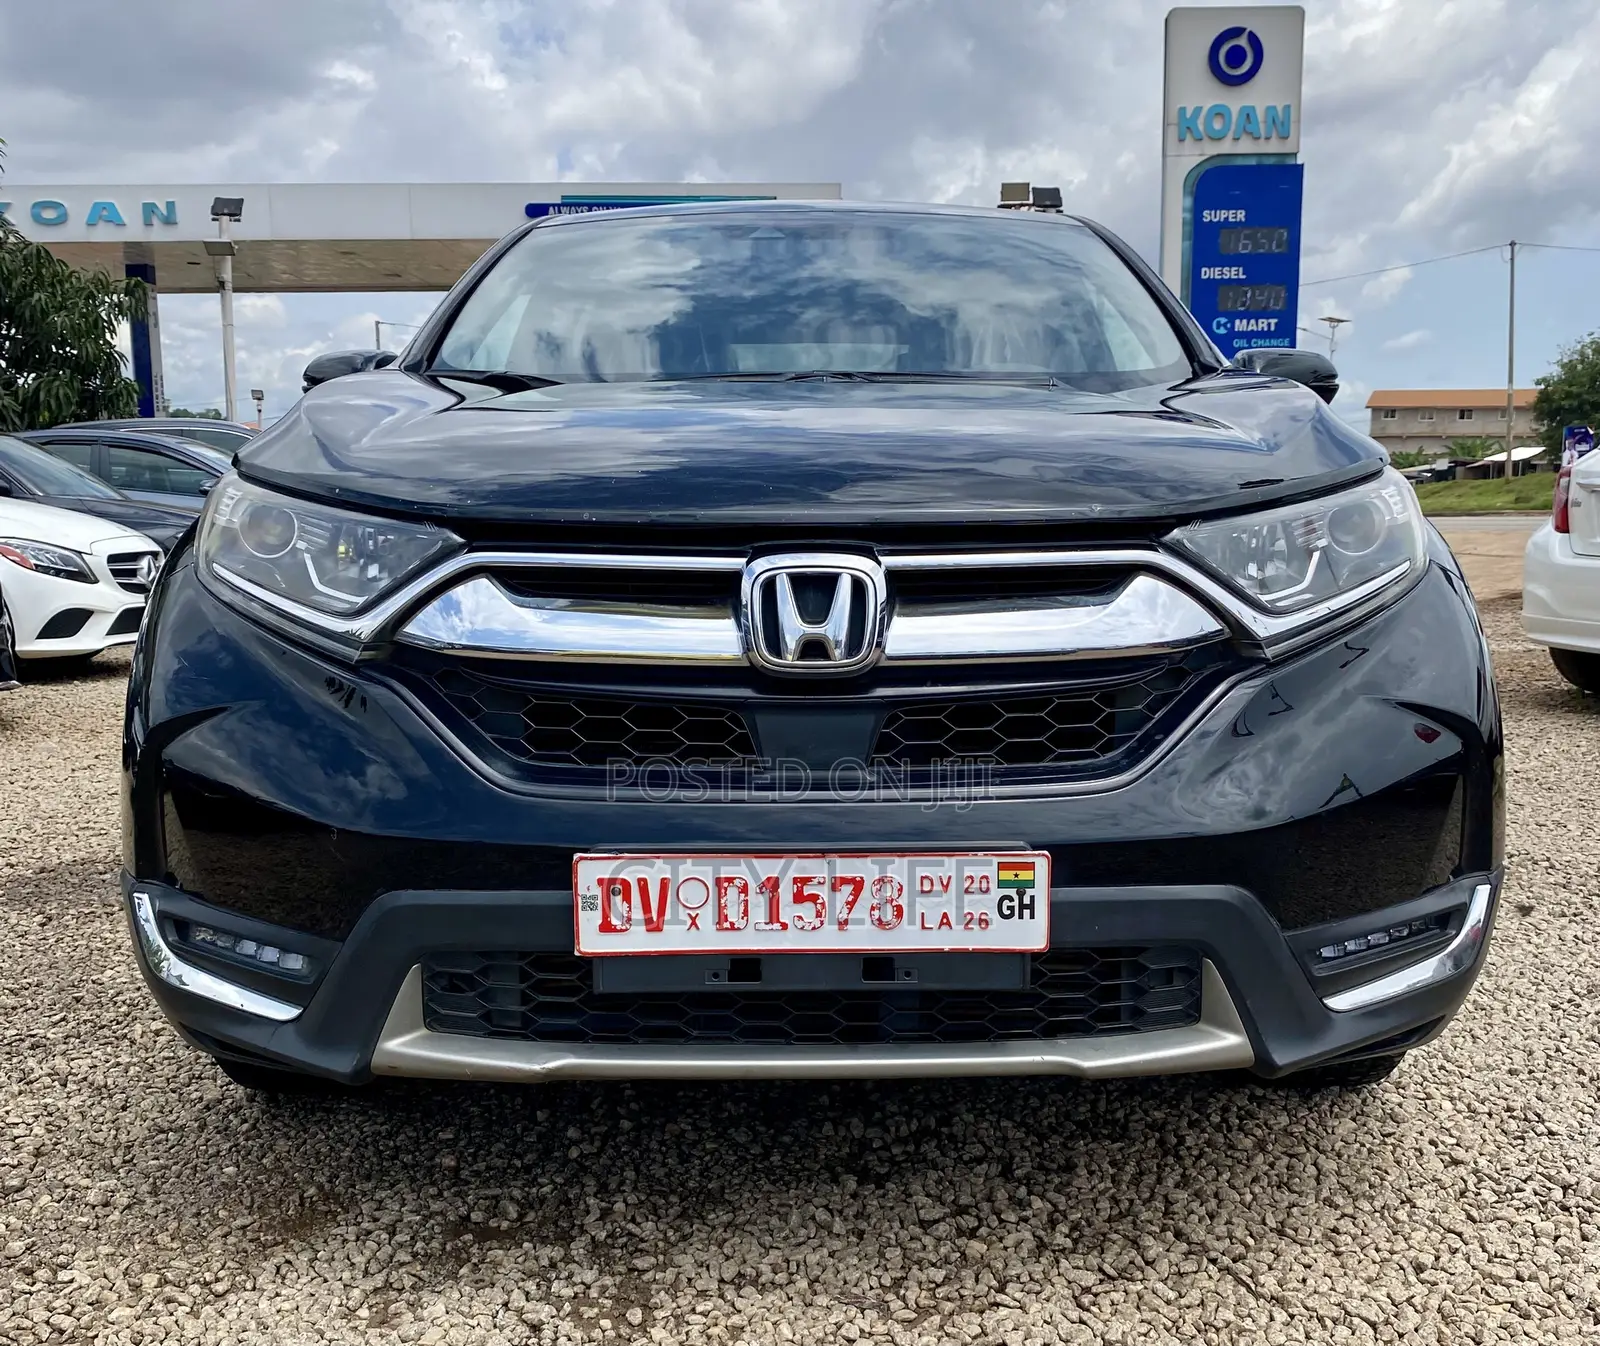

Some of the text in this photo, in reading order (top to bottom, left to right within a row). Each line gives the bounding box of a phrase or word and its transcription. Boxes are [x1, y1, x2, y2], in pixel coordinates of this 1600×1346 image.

[1177, 104, 1291, 142] KOAN
[1202, 209, 1246, 222] SUPER
[1201, 266, 1247, 279] DIESEL
[1234, 318, 1278, 332] MART
[1233, 338, 1291, 348] OIL CHANGE
[920, 874, 991, 894] DV 20
[597, 876, 671, 933] DV
[997, 894, 1036, 920] GH
[920, 911, 990, 931] LA 26
